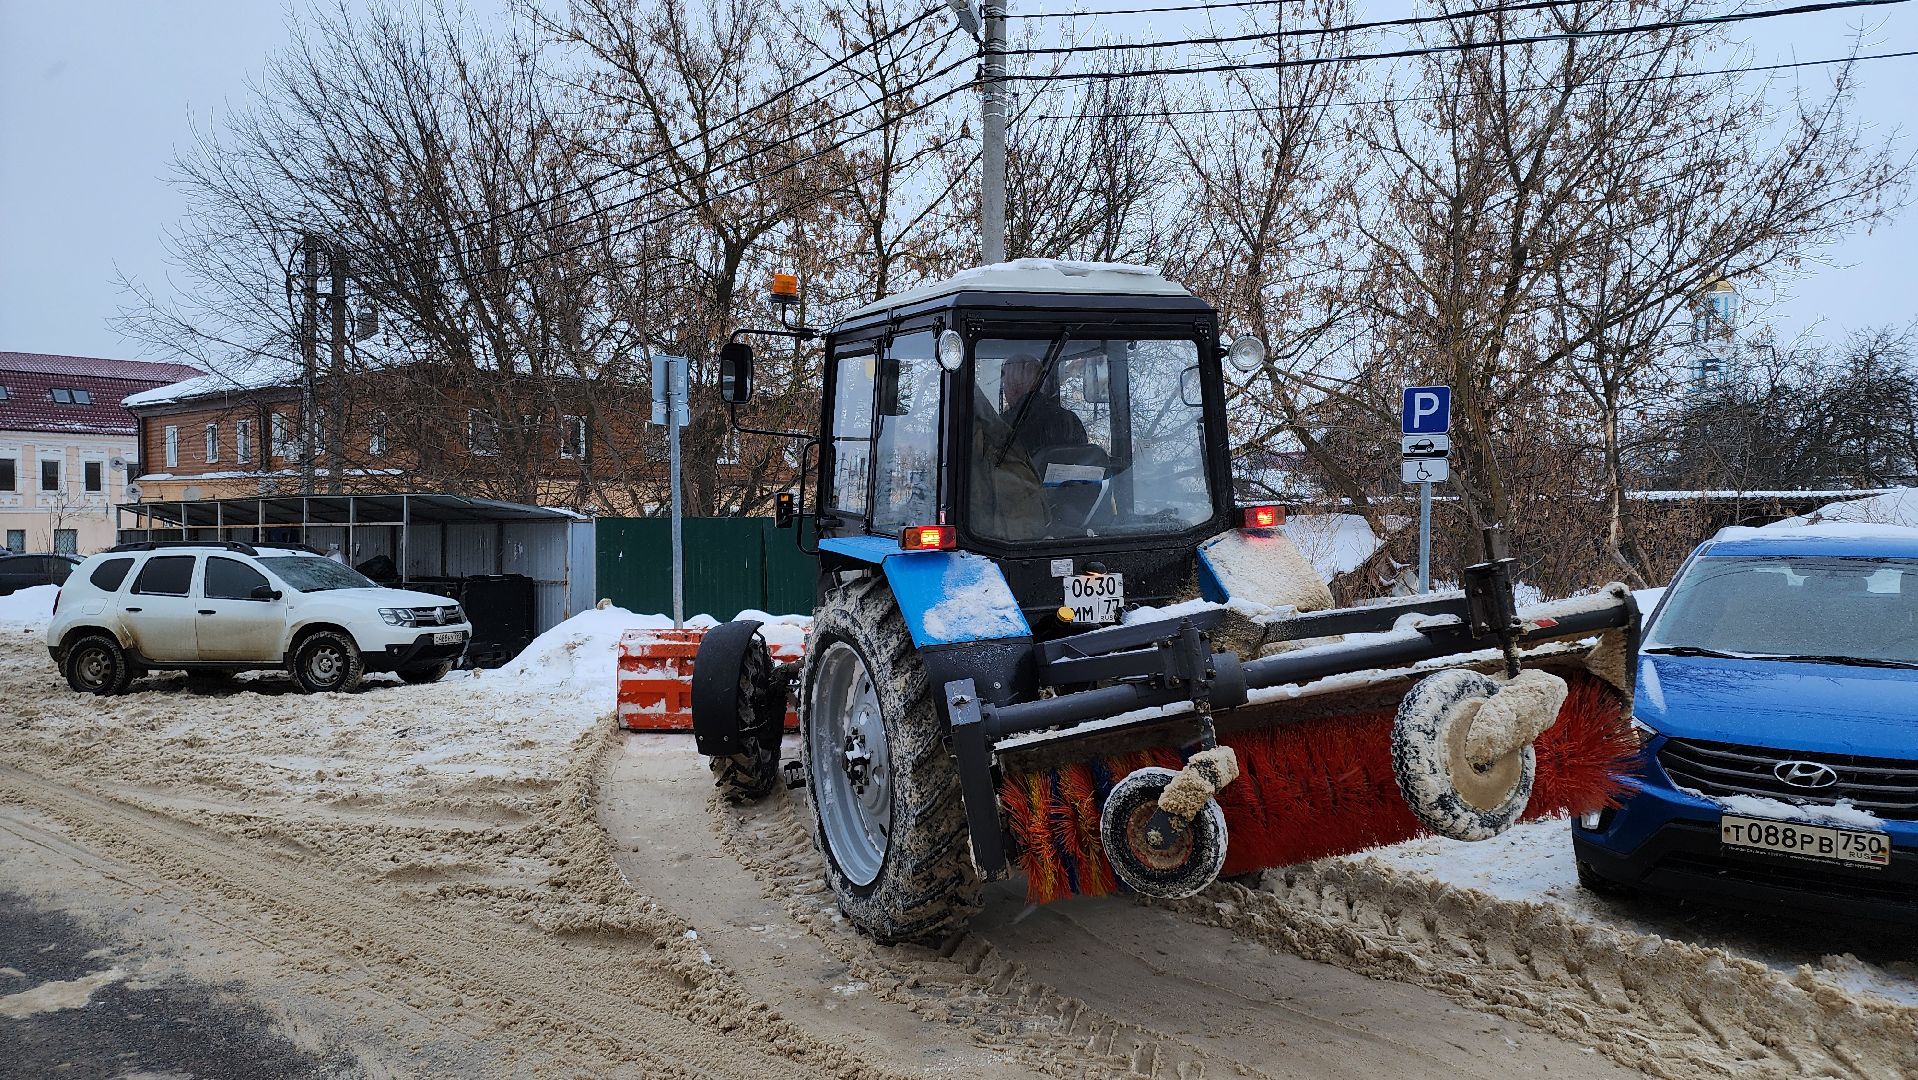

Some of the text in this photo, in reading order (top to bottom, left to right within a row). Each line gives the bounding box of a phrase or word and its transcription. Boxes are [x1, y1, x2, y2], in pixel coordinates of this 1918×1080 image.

[1413, 392, 1440, 429] P
[1072, 576, 1116, 598] 0630
[1730, 822, 1882, 854] Т088РВ 750
[1849, 851, 1870, 860] RUS
